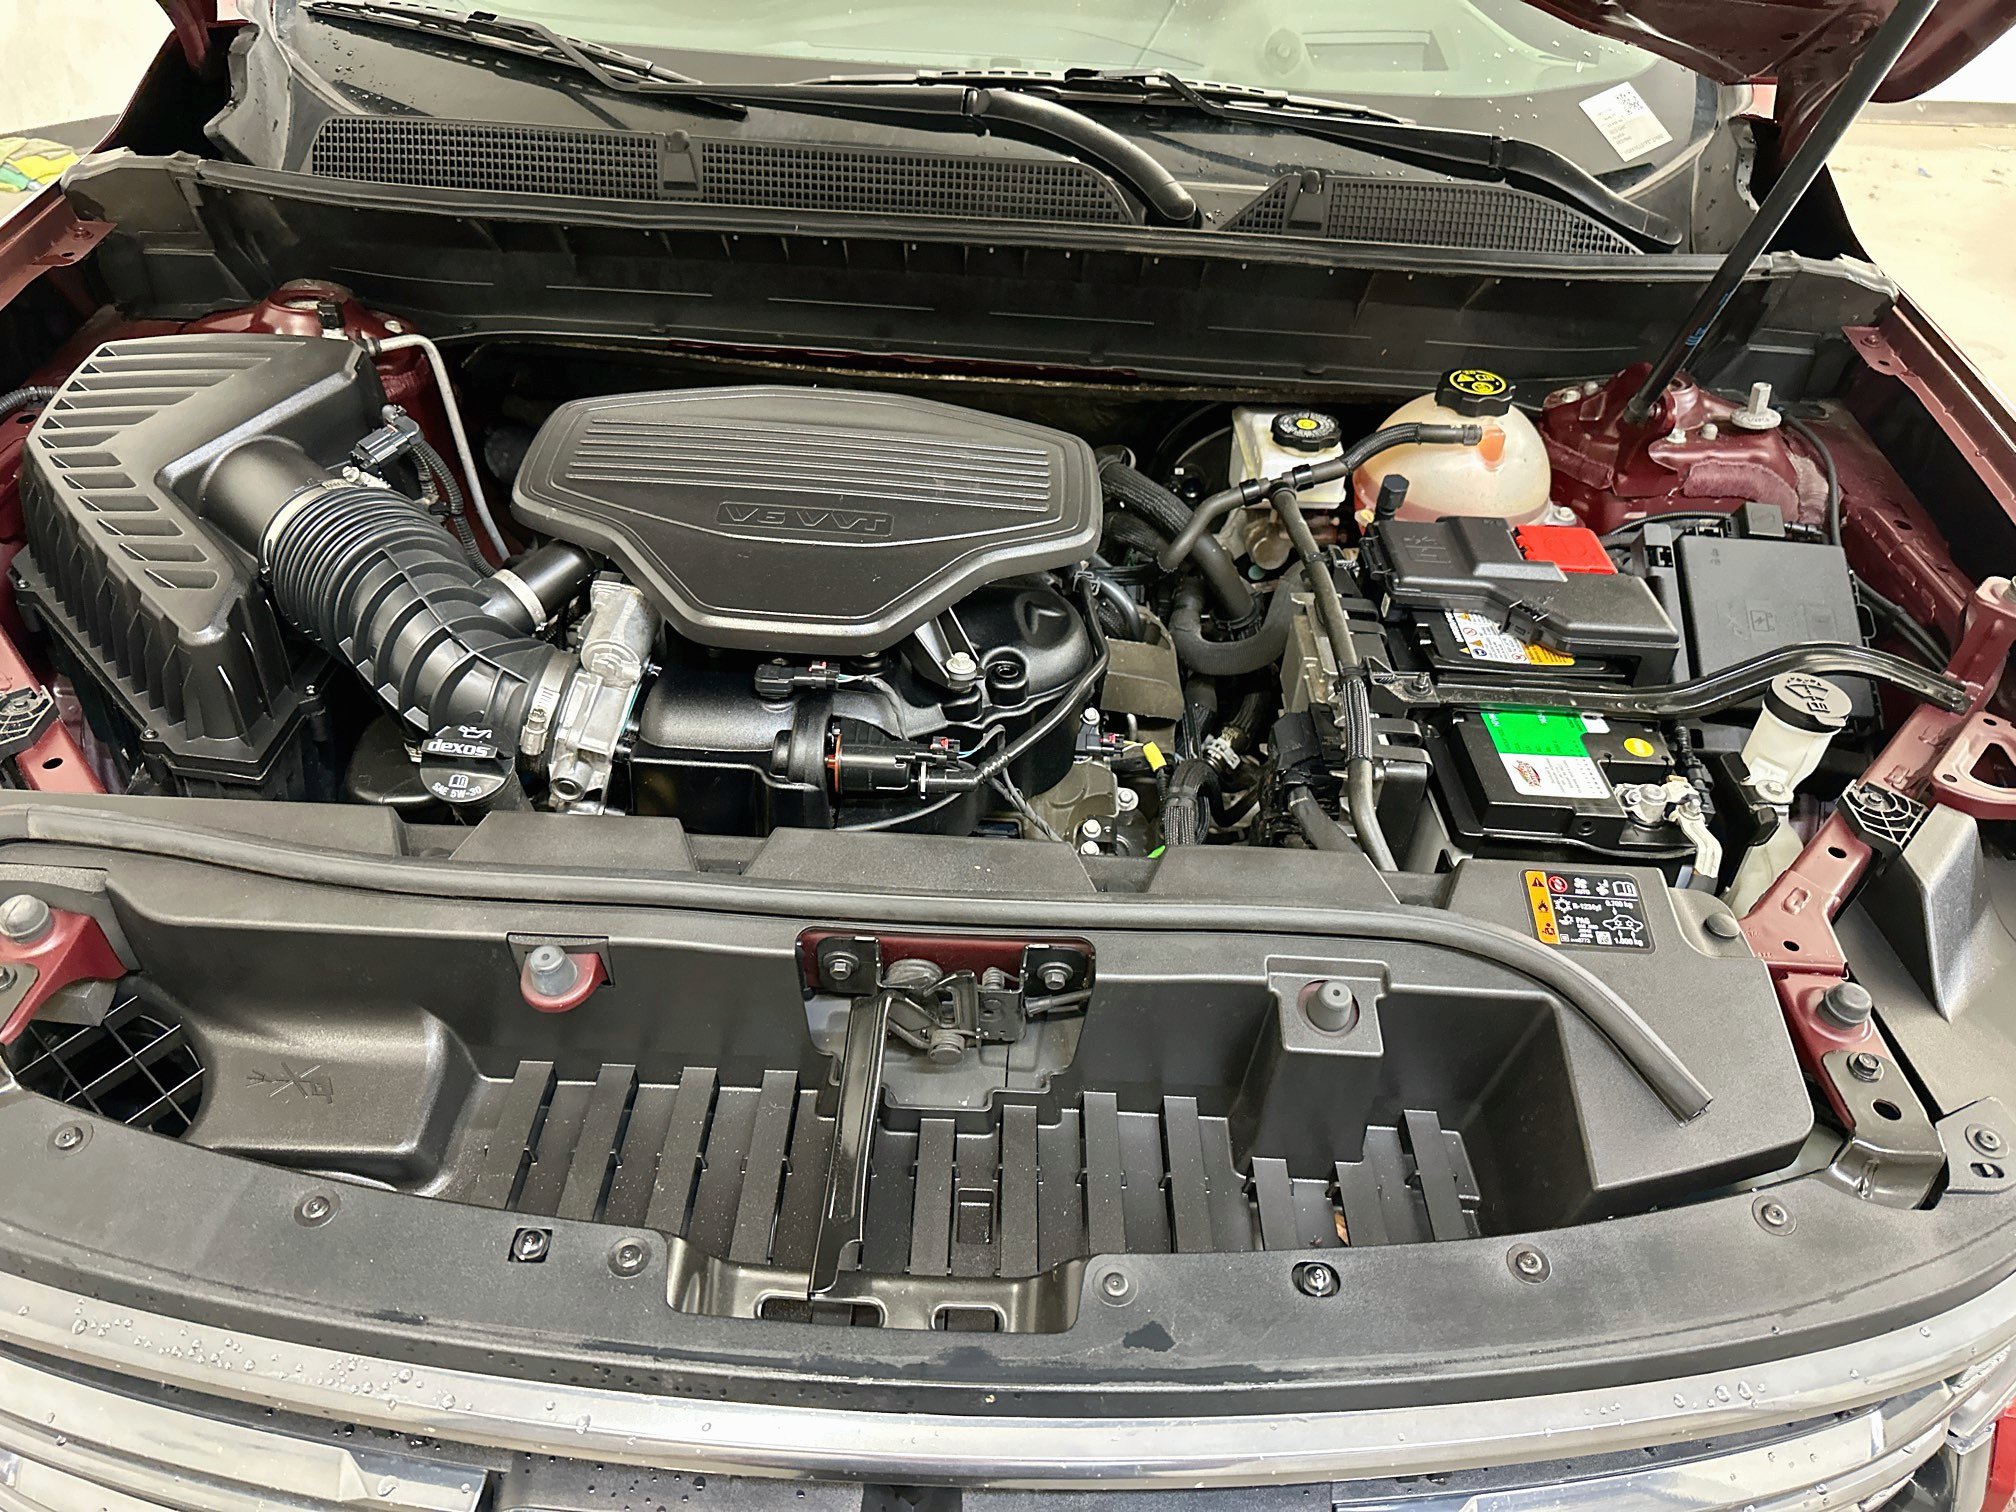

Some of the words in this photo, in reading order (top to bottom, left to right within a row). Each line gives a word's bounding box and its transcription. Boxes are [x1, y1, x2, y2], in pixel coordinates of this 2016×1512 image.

[725, 505, 786, 525] V6
[796, 510, 887, 532] VVT
[427, 739, 491, 757] dexos
[432, 782, 449, 796] SAE
[450, 785, 482, 799] 5W-30
